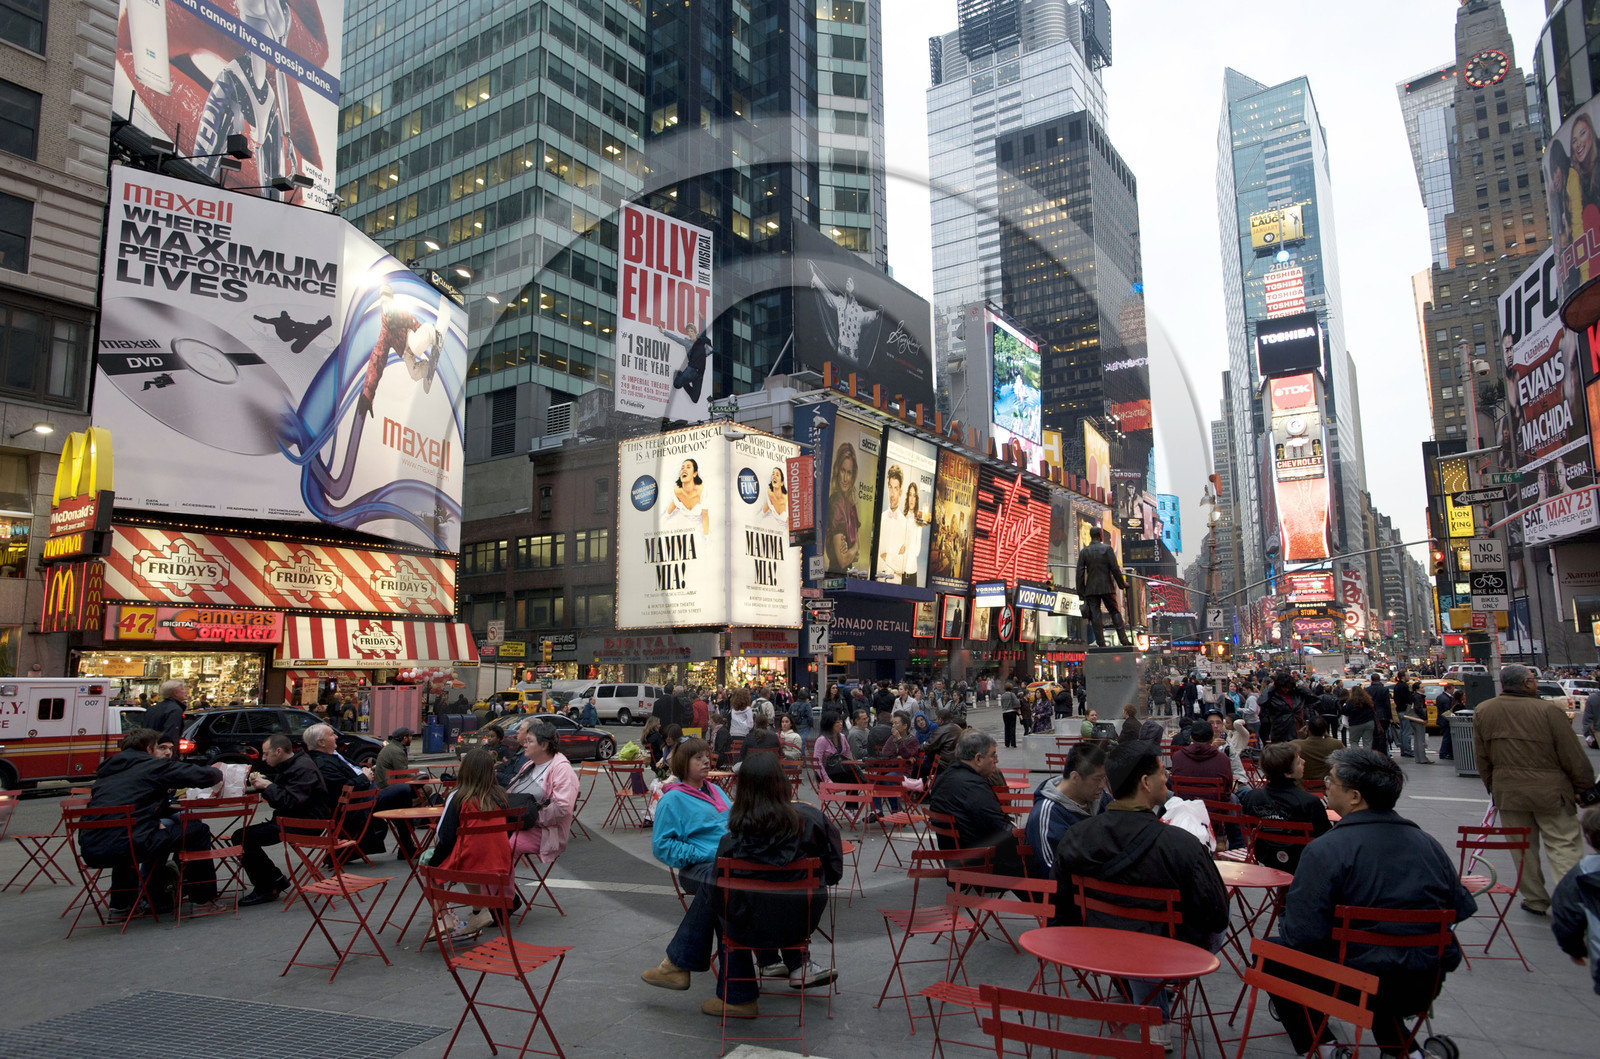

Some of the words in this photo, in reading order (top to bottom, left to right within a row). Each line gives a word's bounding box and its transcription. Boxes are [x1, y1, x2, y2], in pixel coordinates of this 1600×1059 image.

[200, 5, 237, 34] cannot
[239, 20, 257, 48] live
[259, 41, 273, 56] on
[274, 51, 304, 76] gossip
[306, 69, 334, 94] alone.
[305, 165, 323, 181] voted
[306, 192, 314, 201] of
[313, 182, 329, 196] odka
[123, 182, 233, 223] maxell
[123, 204, 231, 241] WHERE
[1251, 215, 1286, 228] LAUGH
[1253, 224, 1279, 235] JANUARY
[120, 219, 338, 284] MAXIMUM
[624, 206, 698, 281] BILLY
[698, 234, 711, 271] MUSICAL
[119, 243, 337, 299] PERFORMANCE
[1265, 267, 1302, 281] TOSHIBA
[1268, 261, 1297, 273] 2009
[116, 258, 248, 303] LIVES
[698, 270, 711, 286] THE
[1266, 278, 1303, 292] TOSHIBA
[622, 263, 711, 336] ELLIOT
[1267, 289, 1304, 301] TOSHIBA
[1505, 253, 1559, 346] UFC
[1267, 298, 1305, 311] TOSHIBA
[1268, 308, 1305, 319] TOSHIBA
[101, 339, 162, 349] maxell
[1260, 327, 1316, 345] TOSHIBA
[636, 335, 671, 363] SHOW
[126, 356, 164, 369] DVD
[621, 353, 631, 368] OF
[634, 356, 648, 372] THE
[627, 375, 650, 387] IMPERIAL
[651, 380, 670, 391] THEATRE
[1518, 351, 1566, 406] EVANS
[1282, 383, 1311, 396] TDK
[1528, 384, 1558, 407] CHAMPION
[1521, 399, 1574, 451] MACHIDA
[382, 416, 451, 472] maxell
[645, 434, 687, 449] FEEL-GOOD
[688, 426, 724, 442] MUSICAL
[749, 434, 776, 451] WORLD'S
[777, 443, 794, 455] MOST
[861, 437, 878, 451] starz
[1531, 430, 1567, 454] CHALLENGER
[636, 451, 643, 461] IS
[645, 451, 650, 460] A
[735, 440, 765, 457] POPULAR
[943, 450, 980, 485] HEIGHTS
[1276, 456, 1322, 469] CHEVROLET
[1566, 460, 1589, 481] SERRA
[1493, 474, 1501, 482] W
[1502, 474, 1513, 482] 46
[790, 461, 800, 528] BIENVENIDOS
[859, 481, 874, 493] Head
[1520, 481, 1540, 501] HUGHES
[858, 490, 874, 502] Case
[1460, 494, 1477, 502] ONE
[1482, 491, 1501, 499] WAY
[51, 504, 95, 525] McDonald's
[1450, 510, 1470, 521] LION
[1523, 507, 1544, 529] SAT.
[1545, 495, 1573, 521] MAY
[1576, 490, 1592, 511] 23
[56, 520, 86, 533] Restaurant
[992, 473, 1042, 580] Virgin
[1451, 521, 1472, 532] KING
[1525, 524, 1539, 537] LIVE
[1539, 521, 1549, 532] ON
[1549, 507, 1594, 529] PAY-PER-VIEW
[644, 533, 697, 564] MAMMA
[745, 530, 785, 561] MAMMA
[1479, 543, 1494, 553] NO
[813, 559, 821, 567] NO
[1473, 554, 1502, 563] TURNS
[148, 562, 217, 578] FRIDAY'S
[655, 562, 686, 591] MIA!
[754, 559, 777, 587] MIA!
[810, 568, 824, 576] TURNS
[276, 571, 333, 586] FRIDAY'S
[380, 579, 428, 594] FRIDAY'S
[1019, 589, 1056, 607] VORNADO
[811, 626, 820, 634] NO
[832, 618, 876, 631] ORNADO
[876, 619, 910, 633] RETAIL
[1295, 621, 1333, 631] YAHOO!
[360, 637, 396, 647] FRIDAY'S
[603, 635, 678, 649] DIGITAL
[753, 631, 788, 642] DIGITAL
